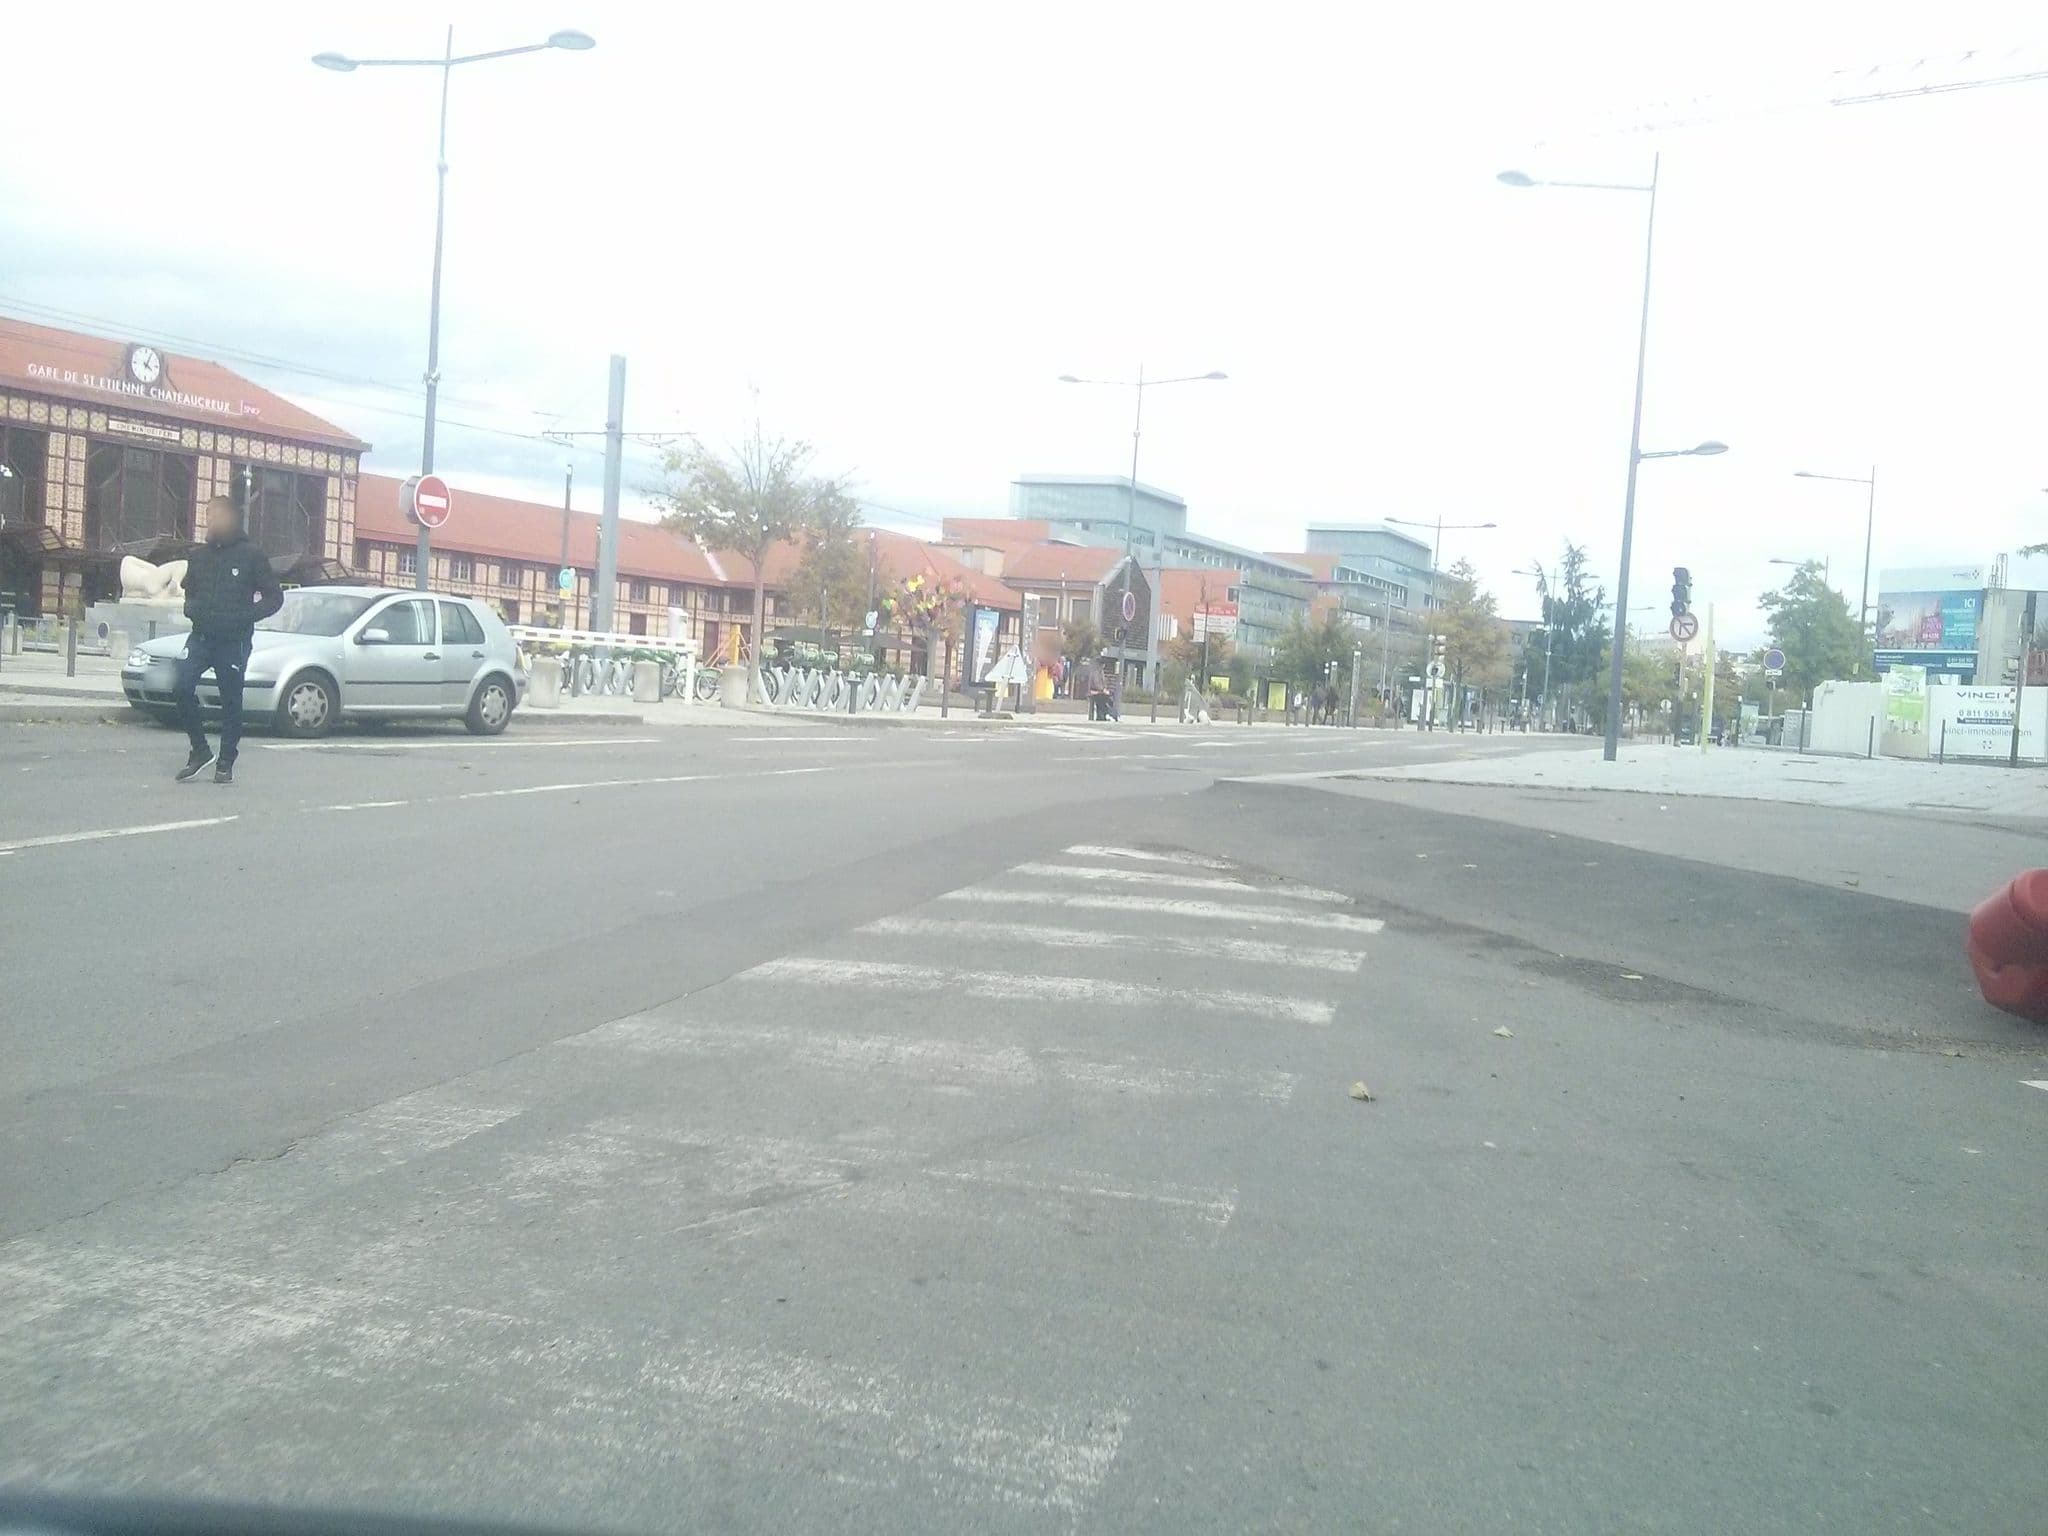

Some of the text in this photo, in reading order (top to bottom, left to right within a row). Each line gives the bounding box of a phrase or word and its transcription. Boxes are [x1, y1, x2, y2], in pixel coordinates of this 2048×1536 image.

[27, 363, 231, 413] GARE DE ST ETIENNE CHATEAUCREUX
[1956, 691, 2000, 699] VINCI
[1966, 709, 1979, 717] 811
[1984, 710, 1999, 718] 555
